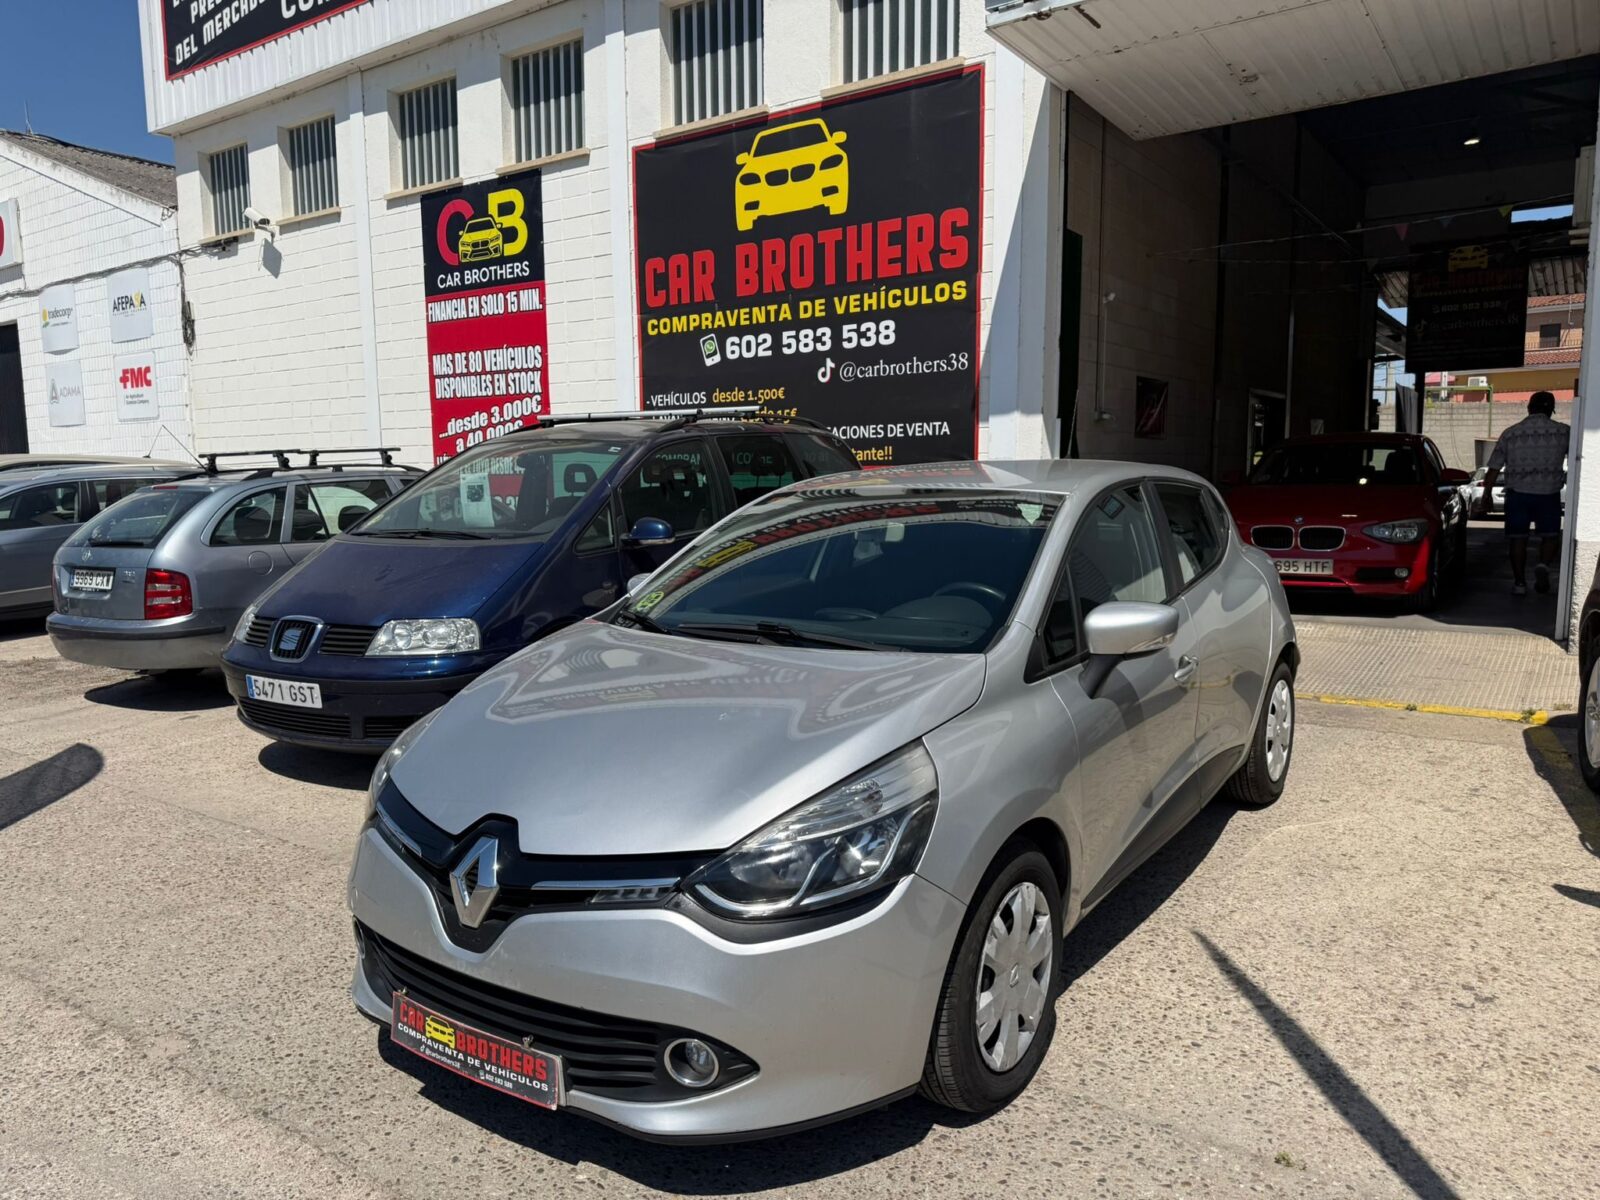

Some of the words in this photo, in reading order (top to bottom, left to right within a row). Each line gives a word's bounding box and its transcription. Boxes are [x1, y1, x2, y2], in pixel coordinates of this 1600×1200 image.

[175, 33, 198, 66] DEL
[644, 249, 716, 308] CAR
[735, 207, 969, 297] BROTHERS
[437, 272, 462, 289] CAR
[464, 261, 530, 285] BROTHERS
[112, 291, 147, 313] AFEPAA
[428, 298, 467, 322] FINANCIA
[468, 296, 480, 318] EN
[481, 292, 505, 317] SOLO
[505, 291, 518, 313] 15
[519, 288, 543, 312] MIN.
[646, 303, 792, 335] COMPRAVENTA
[799, 298, 826, 318] DE
[833, 280, 967, 315] VEHÍCULOS
[725, 333, 773, 360] 602
[781, 327, 832, 354] 583
[841, 319, 896, 349] 538
[432, 353, 453, 376] MAS
[454, 352, 468, 374] DE
[468, 351, 482, 373] 80
[483, 344, 542, 372] VEHÍCULOS
[839, 352, 969, 382] @carbrothers38
[119, 366, 152, 389] FMC
[435, 374, 493, 399] DISPONIBLES
[494, 373, 506, 396] EN
[507, 370, 542, 395] STOCK
[490, 395, 542, 424] 3.000€
[712, 387, 745, 403] desde
[747, 387, 785, 404] 1.500€
[827, 424, 884, 439] ACIONES
[887, 424, 904, 438] DE
[905, 421, 951, 437] VENTA
[456, 438, 465, 453] a
[1274, 560, 1300, 572] 695
[1304, 560, 1330, 573] HTF
[253, 679, 285, 701] 5471
[288, 684, 315, 705] GST
[400, 1002, 424, 1033] CAR
[456, 1030, 548, 1082] BROTHERS
[397, 1022, 465, 1061] COMPRAVENTA
[467, 1056, 481, 1068] DE
[484, 1062, 549, 1092] VEHÍCULOS
